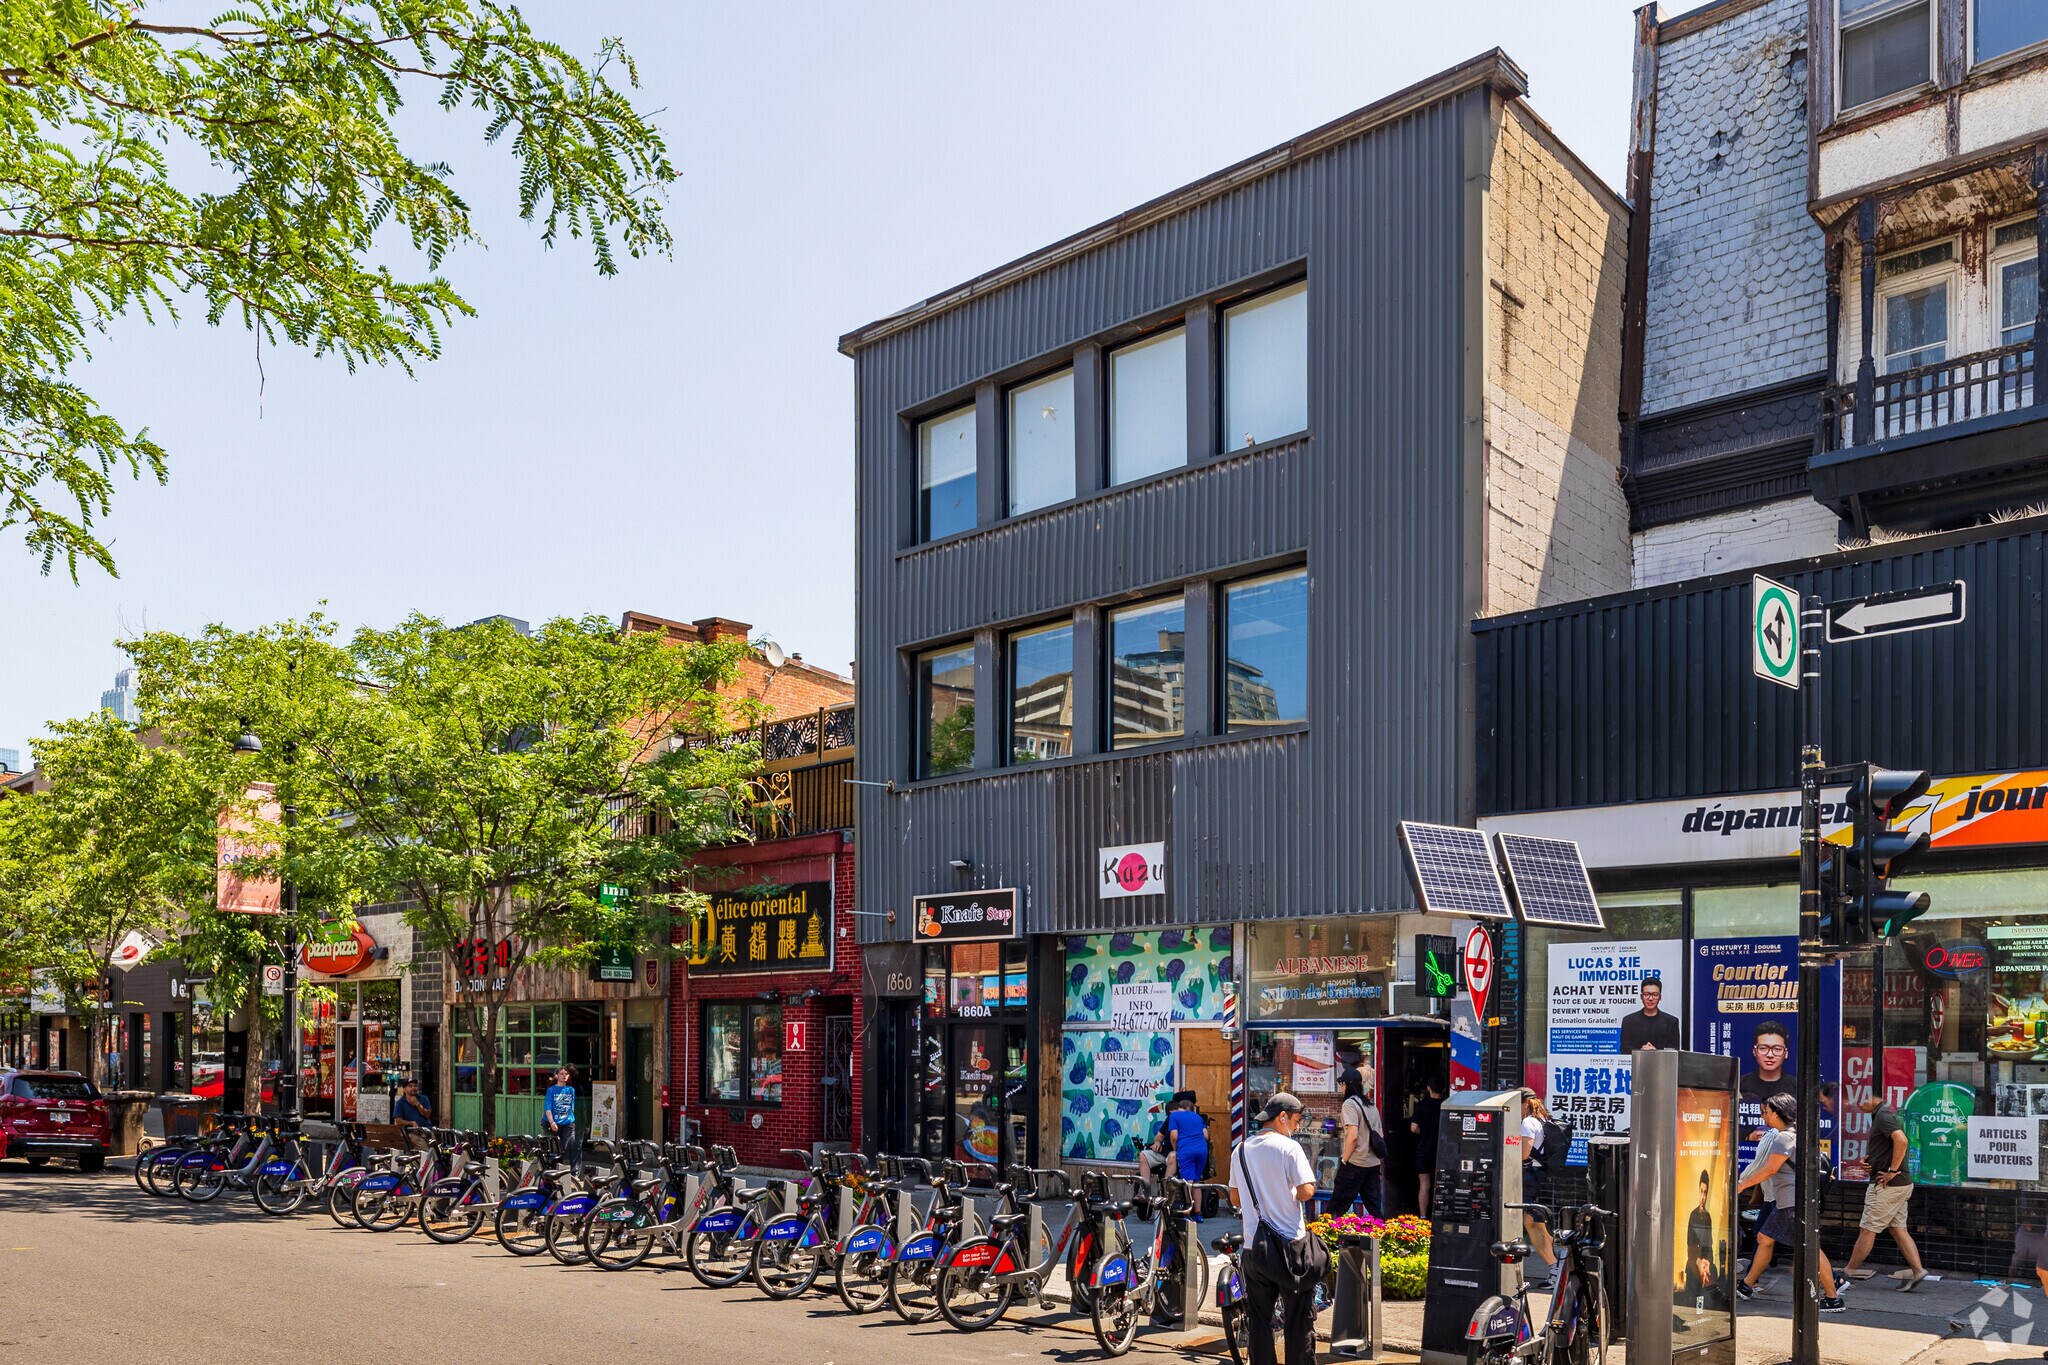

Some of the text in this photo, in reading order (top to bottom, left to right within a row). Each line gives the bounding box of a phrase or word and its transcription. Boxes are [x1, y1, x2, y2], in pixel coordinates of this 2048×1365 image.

[1682, 802, 1853, 836] dépanneu
[1102, 857, 1164, 885] Kazu
[750, 890, 806, 917] oriental
[941, 902, 1012, 926] Knafe Stop
[333, 940, 359, 961] pizza
[1273, 954, 1369, 976] ALBANESE
[1568, 957, 1641, 969] LUCAS XIE
[1712, 963, 1788, 981] Courtier
[887, 972, 912, 991] 1860
[1579, 969, 1662, 982] IMMOBILIER
[1113, 987, 1120, 996] A
[1121, 985, 1149, 995] LOUER
[1261, 981, 1382, 1000] Salon de Barbier
[1553, 985, 1638, 996] ACHAT VENTE
[1717, 981, 1799, 999] Immobili
[958, 1006, 992, 1017] 1860A
[1129, 1000, 1153, 1011] INFO
[1112, 1011, 1169, 1031] 514-677-7766
[1095, 1053, 1101, 1061] A
[1102, 1052, 1129, 1062] LOUER
[1111, 1067, 1134, 1077] INFO
[1847, 1056, 1873, 1085] ÇA
[1094, 1078, 1149, 1098] 514-677-7766
[1979, 1128, 2027, 1140] ARTICLES
[1989, 1142, 2017, 1152] POUR
[1973, 1153, 2033, 1166] VAPOTEURS
[562, 1203, 583, 1211] beneva
